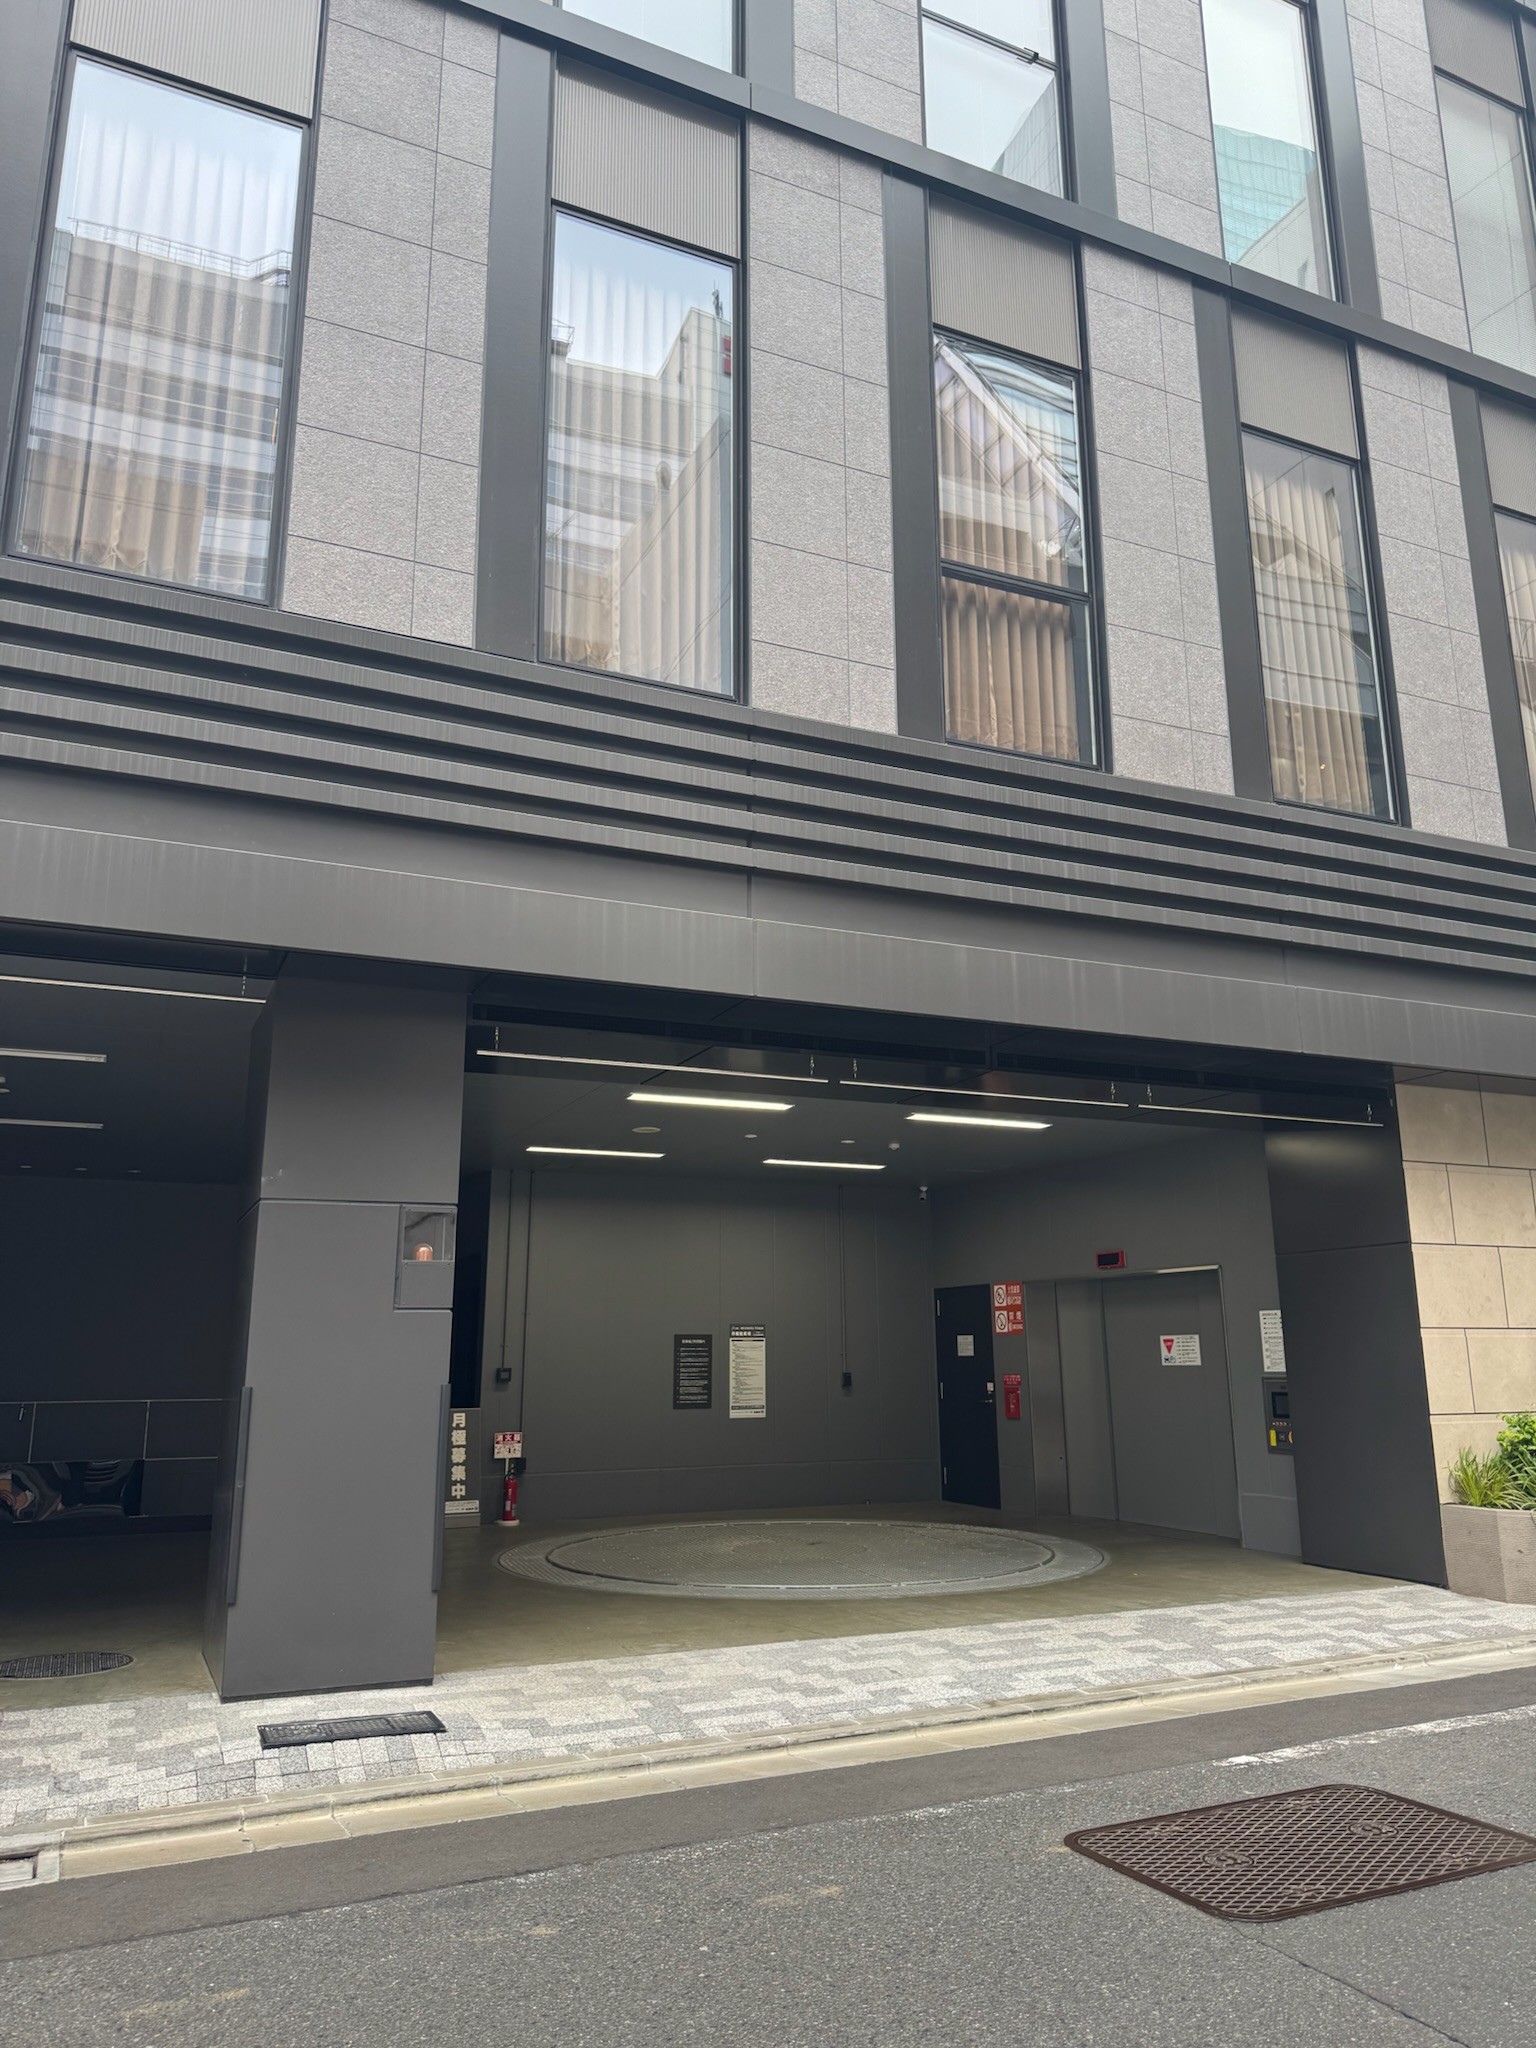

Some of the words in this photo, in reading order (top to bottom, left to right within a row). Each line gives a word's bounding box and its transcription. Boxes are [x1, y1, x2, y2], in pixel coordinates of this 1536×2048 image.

[451, 1412, 467, 1499] 月極募集中
